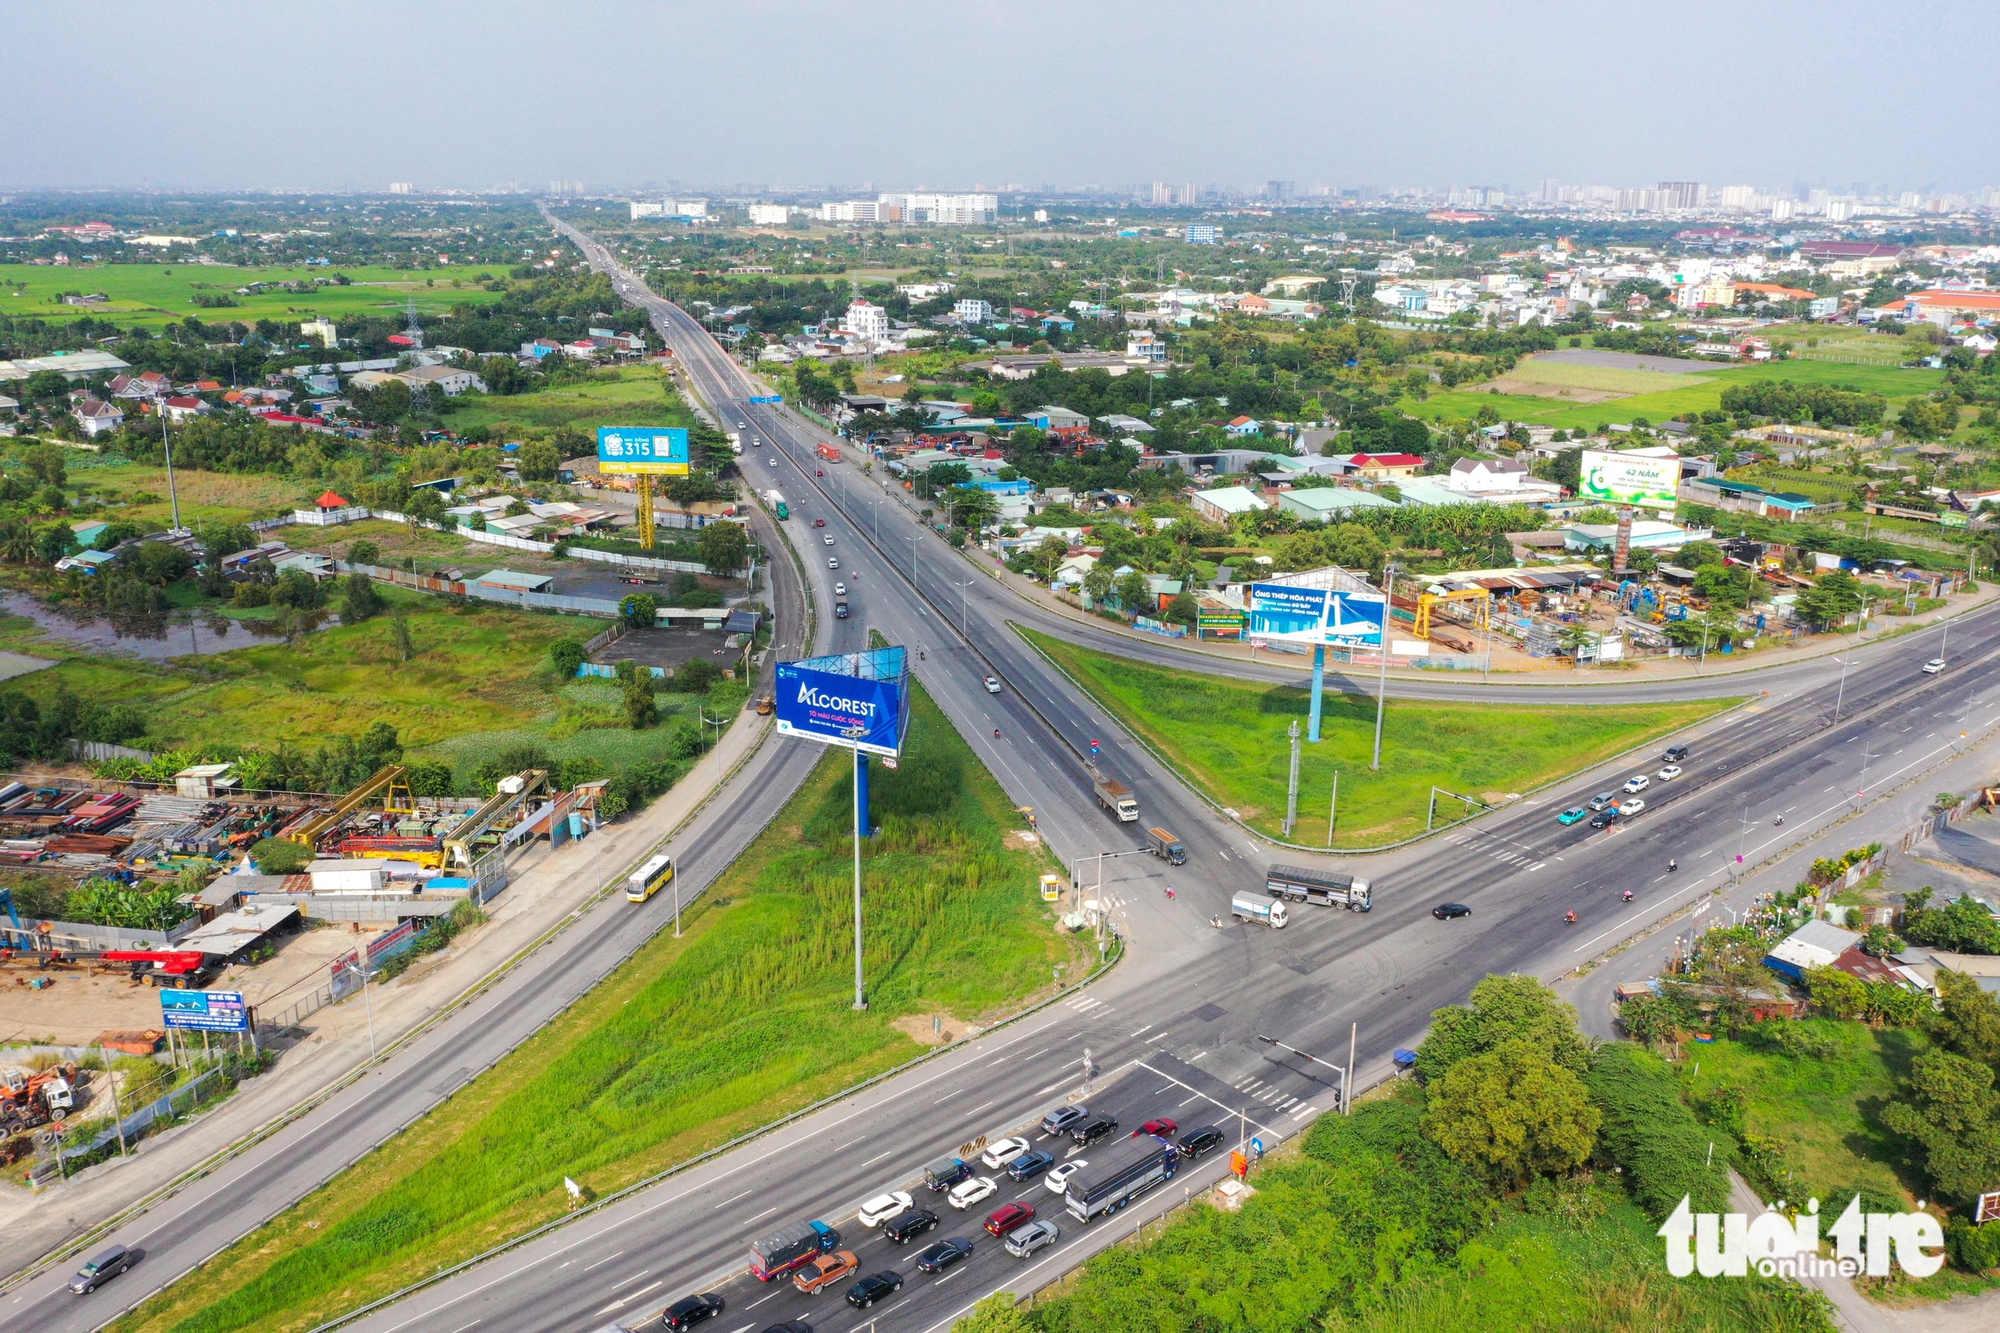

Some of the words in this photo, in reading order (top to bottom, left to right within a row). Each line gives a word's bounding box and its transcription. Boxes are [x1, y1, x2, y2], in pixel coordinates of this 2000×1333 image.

[624, 442, 650, 456] 315
[1638, 469, 1659, 479] NĂM
[1271, 592, 1288, 600] THÉP
[1289, 593, 1305, 602] HÒA
[1305, 595, 1323, 603] PHÁT
[797, 681, 876, 717] ALCOREST
[831, 713, 847, 723] CUỘC
[848, 716, 864, 726] SỐNG
